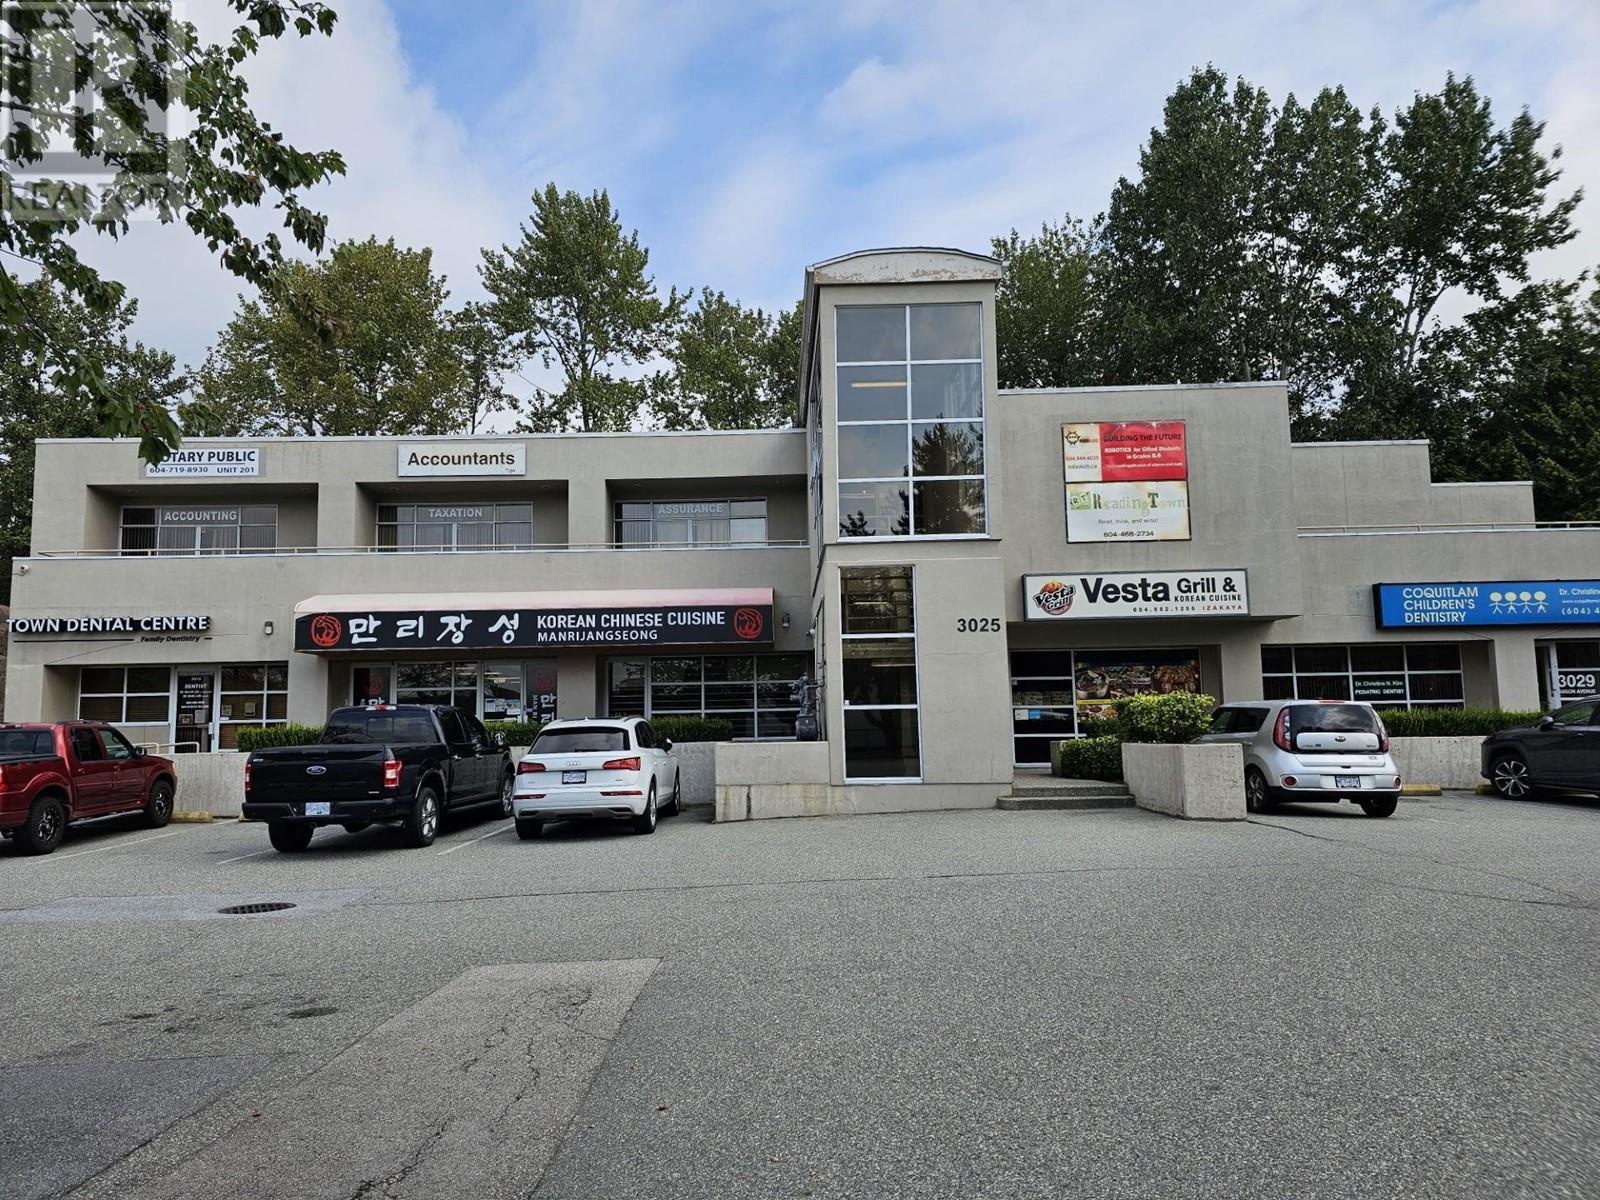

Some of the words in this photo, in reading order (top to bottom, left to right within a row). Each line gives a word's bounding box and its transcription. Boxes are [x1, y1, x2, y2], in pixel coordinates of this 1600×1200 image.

[1104, 433, 1138, 442] BUILDING
[1140, 433, 1154, 441] THE
[208, 450, 256, 462] PUBLIC
[407, 451, 516, 466] Accountants
[428, 508, 483, 518] TAXATION
[658, 503, 723, 514] ASSURANCE
[164, 511, 237, 521] ACCOUNTING
[1035, 585, 1075, 607] Vesta
[1080, 577, 1171, 604] Vesta
[1176, 577, 1216, 594] Grill
[1222, 576, 1237, 593] &
[1402, 586, 1479, 599] COQUITLAM
[1559, 588, 1570, 596] Dr.
[1046, 596, 1069, 610] Grill
[1174, 595, 1206, 603] KOREAN
[1209, 594, 1242, 602] CUISINE
[1403, 599, 1476, 611] CHILDREN'S
[1404, 611, 1467, 623] DENTISTRY
[1561, 607, 1591, 616] (604)
[7, 618, 60, 632] TOWN
[66, 617, 133, 632] DENTAL
[140, 616, 208, 630] CENTRE
[537, 615, 596, 629] KOREAN
[601, 613, 663, 628] CHINESE
[667, 611, 726, 625] CUISINE
[957, 618, 1001, 632] 3025
[166, 635, 200, 643] Dentistry
[537, 630, 658, 642] MANRIJANGSEONG
[1558, 674, 1596, 688] 3029
